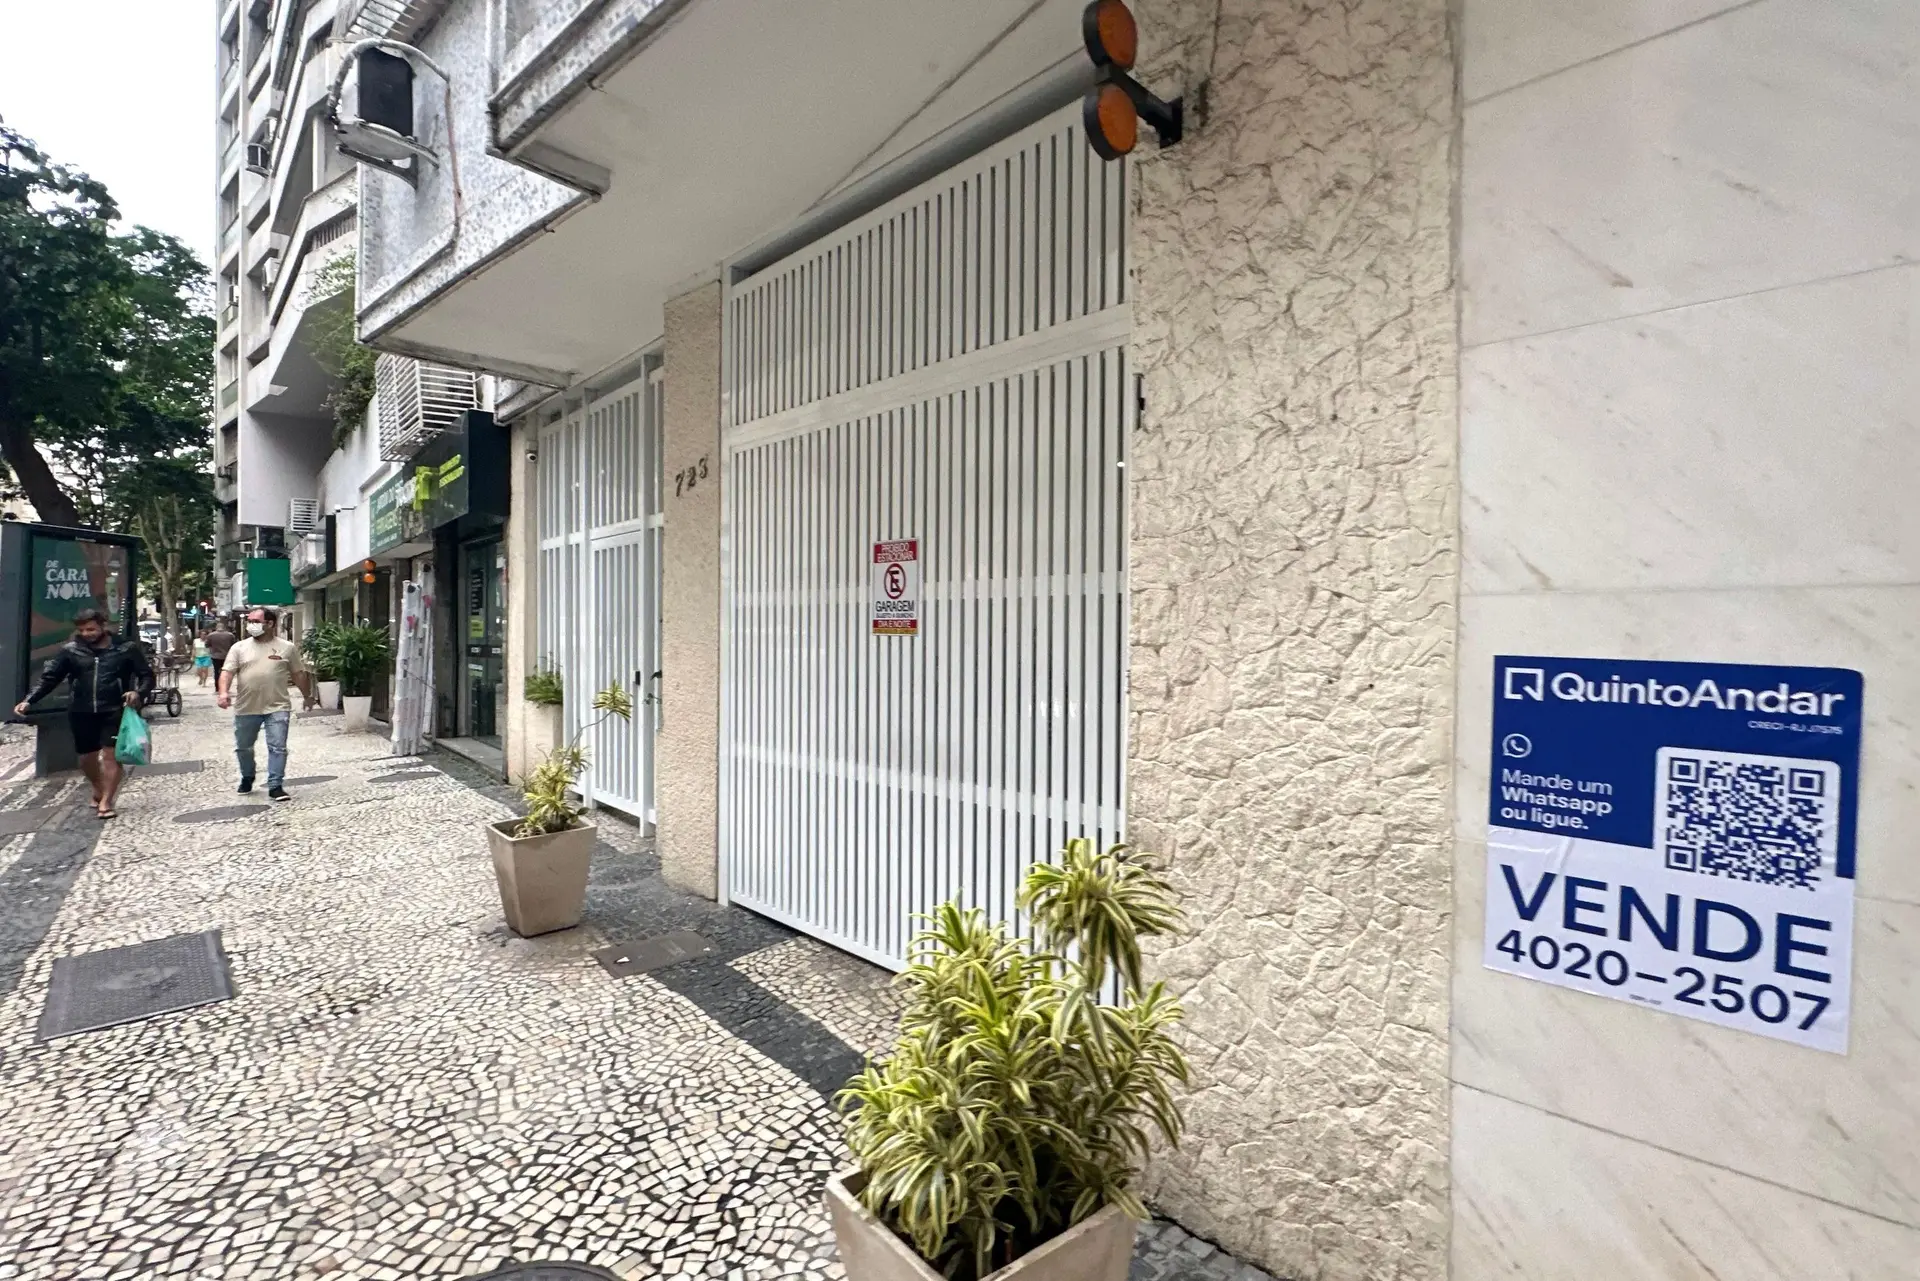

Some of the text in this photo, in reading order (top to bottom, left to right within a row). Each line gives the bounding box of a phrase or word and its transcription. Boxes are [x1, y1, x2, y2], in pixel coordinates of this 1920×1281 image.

[675, 453, 709, 497] 723
[45, 560, 59, 568] DE
[45, 568, 88, 582] CARA
[44, 582, 91, 600] NOVA
[875, 600, 915, 612] GARAGEM
[1551, 671, 1845, 717] QuintoAndar
[1501, 768, 1613, 796] Mande um
[1501, 786, 1613, 816] Whatsapp
[1500, 806, 1589, 830] ou ligue.
[1500, 864, 1832, 984] VENDE
[1496, 929, 1831, 1031] 4020-2507
